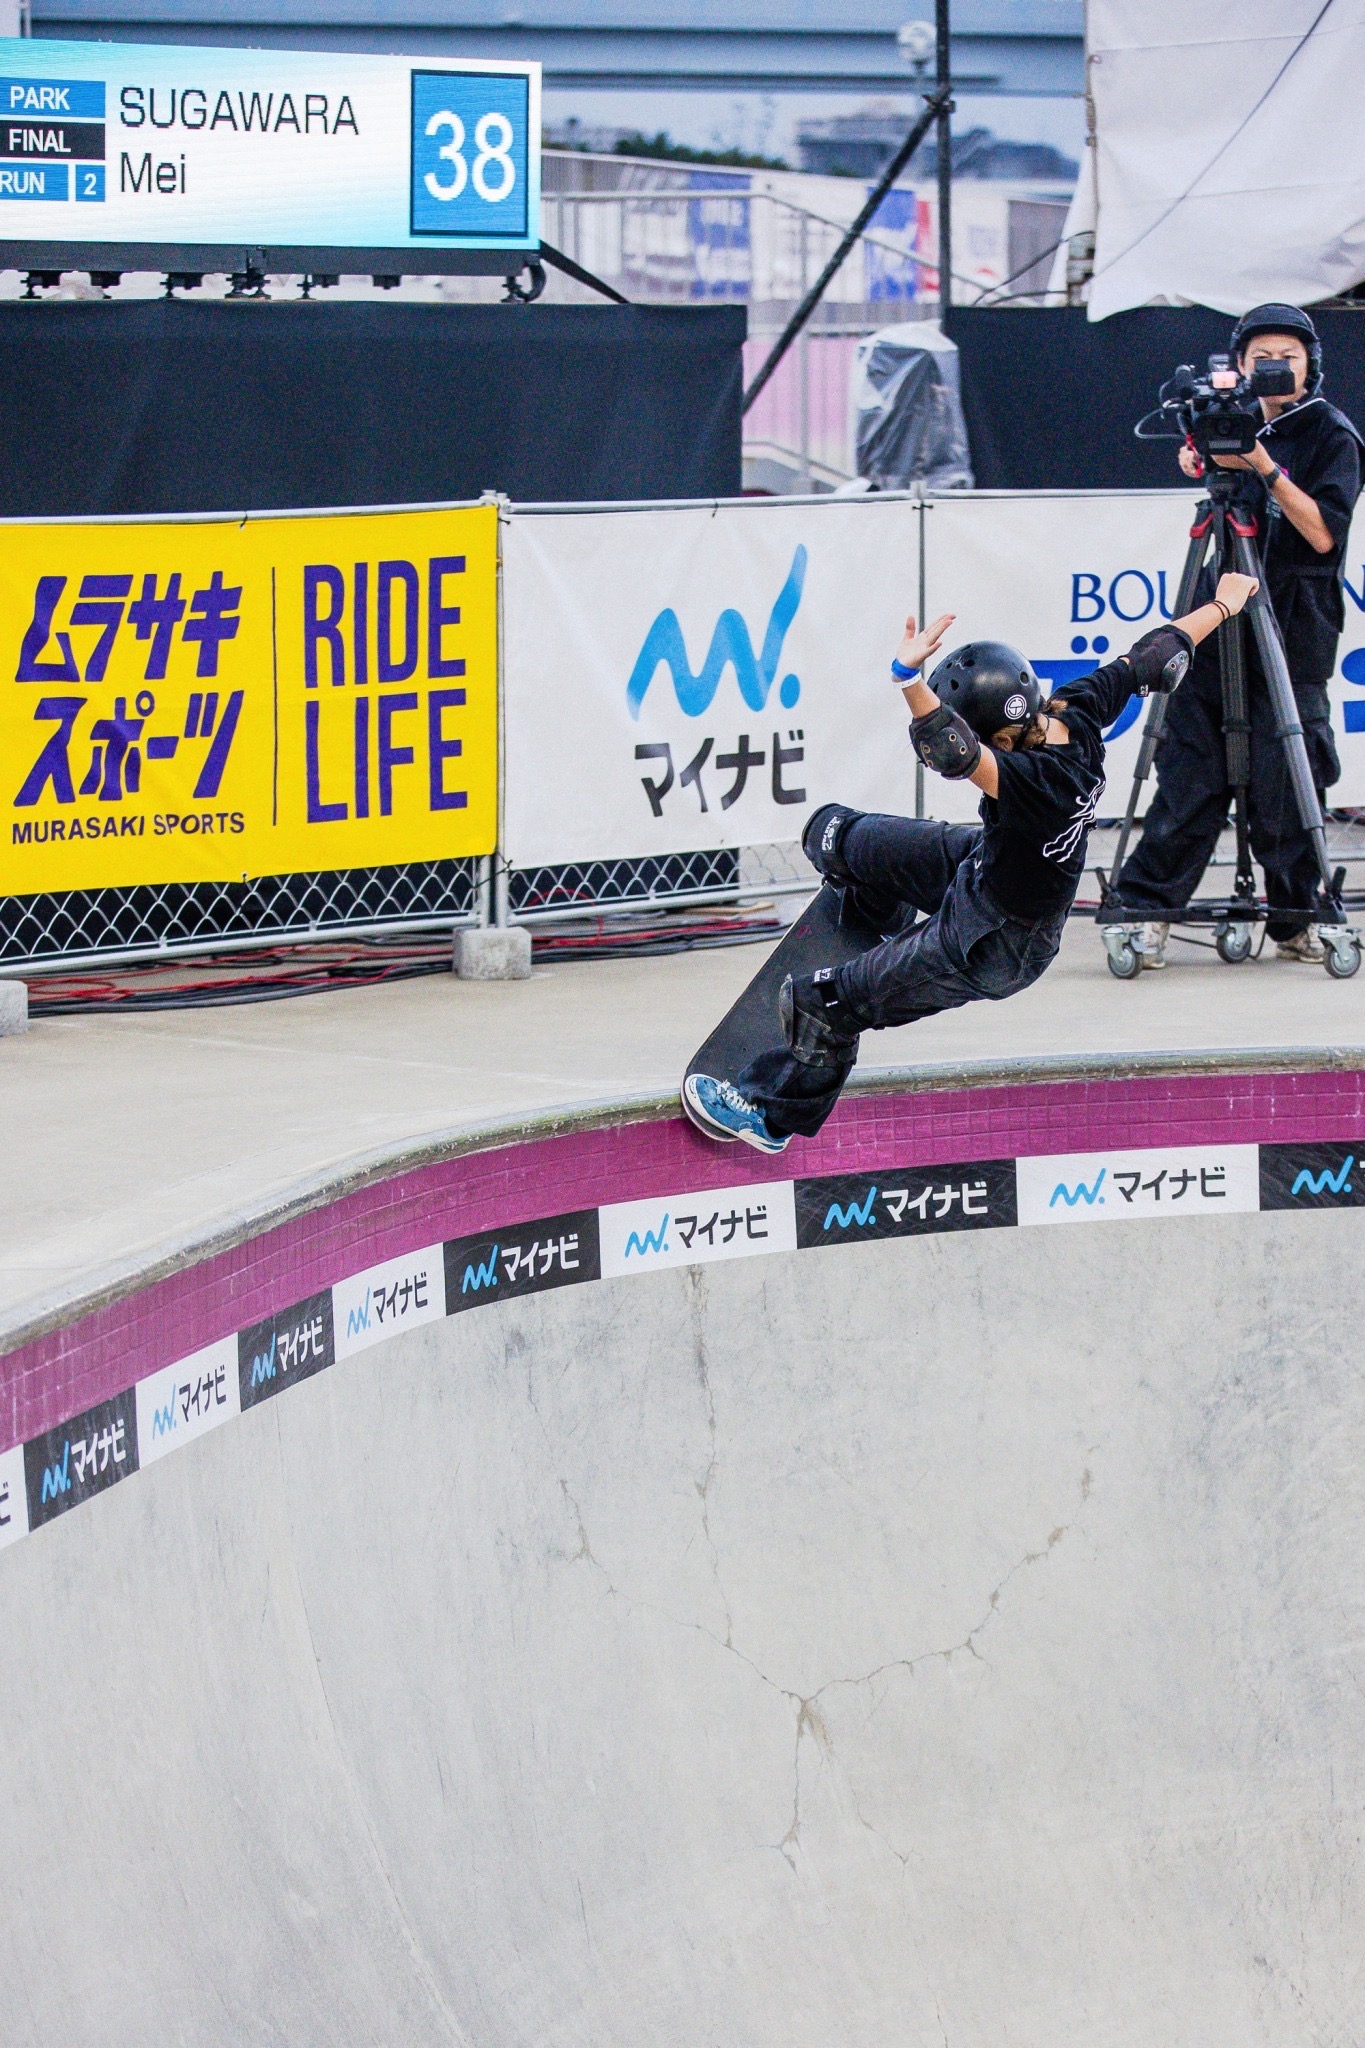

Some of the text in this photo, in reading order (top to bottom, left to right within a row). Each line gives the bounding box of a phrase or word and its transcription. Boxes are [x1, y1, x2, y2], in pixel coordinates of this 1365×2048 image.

[10, 86, 70, 110] PARK
[120, 87, 359, 135] SUGAWARA
[9, 129, 71, 152] FINAL
[423, 110, 517, 202] 38
[0, 171, 97, 195] RUN 2
[120, 152, 186, 194] Mei
[15, 571, 243, 683] ムラサキ
[304, 556, 467, 689] RIDE
[13, 690, 245, 807] スポーツ
[305, 688, 468, 824] LIFE
[634, 729, 807, 817] マイナビ
[12, 812, 245, 844] MURASAKI SPORTS
[881, 1181, 988, 1222] マイナビ
[1113, 1166, 1226, 1203] マイナビ
[674, 1205, 768, 1249] マイナビ
[501, 1233, 580, 1282] マイナビ
[373, 1271, 428, 1324] マイナビ
[277, 1315, 324, 1372] マイナビ
[179, 1364, 227, 1422] マイナビ
[71, 1418, 126, 1484] マイナビ
